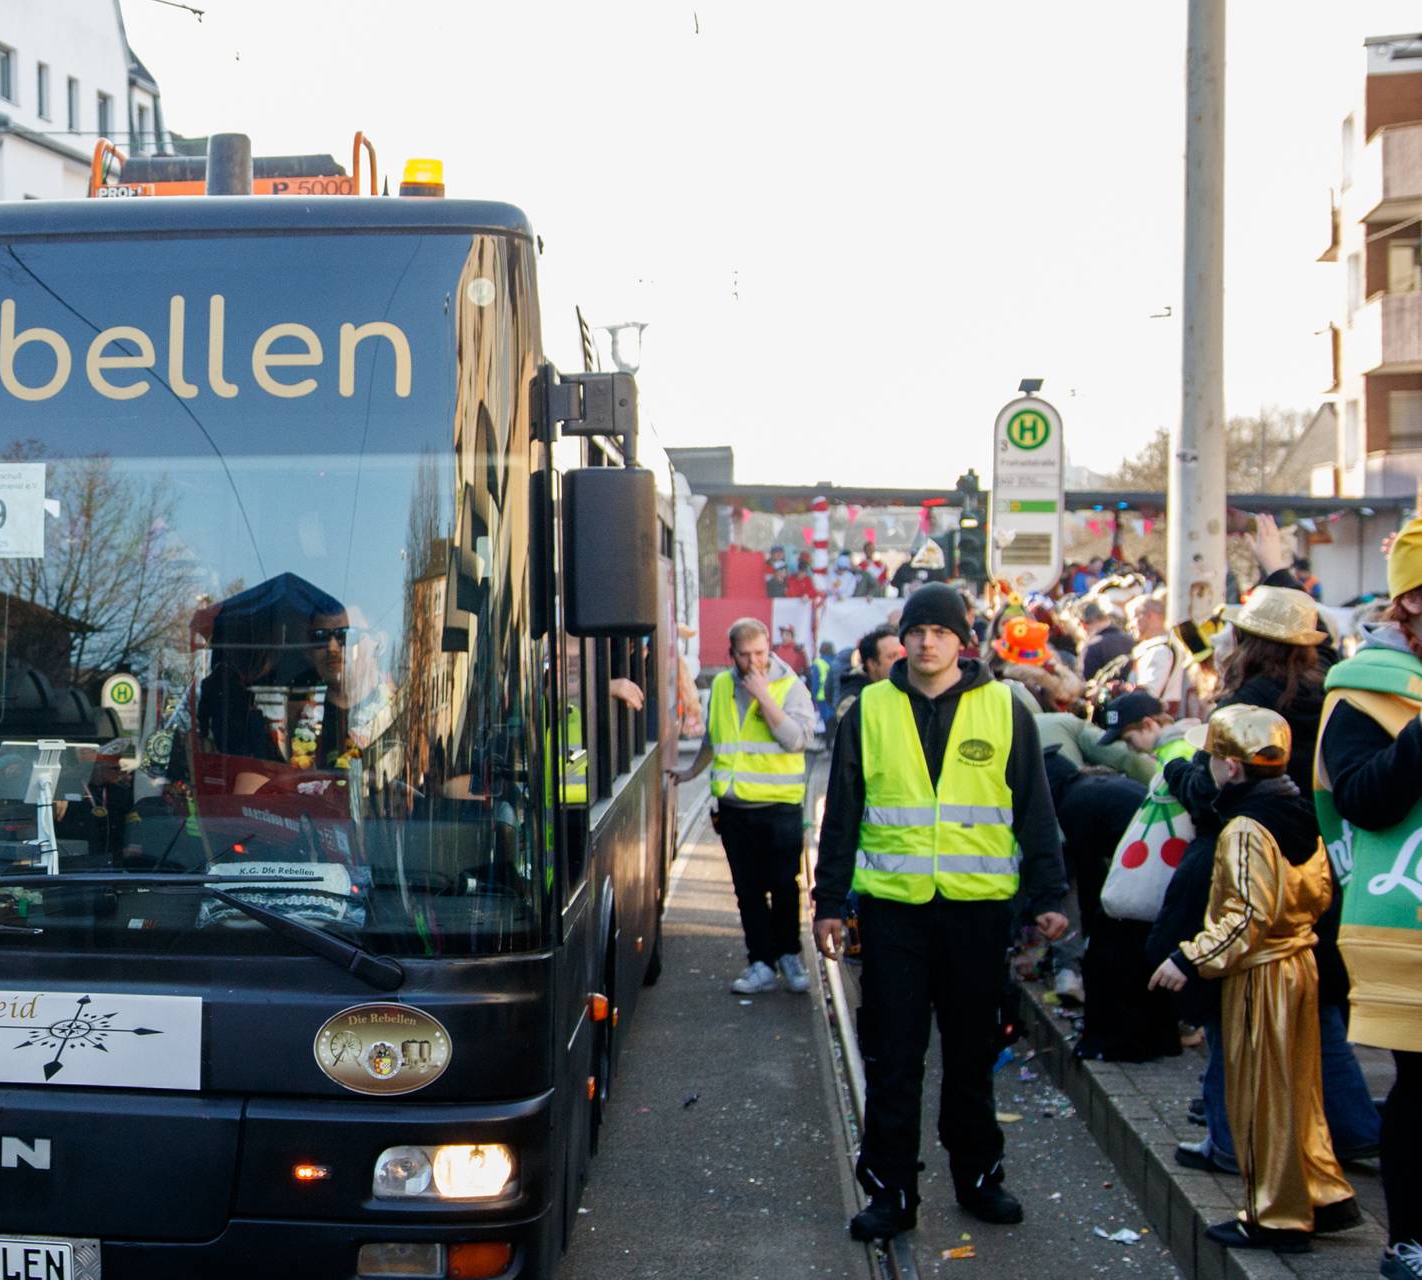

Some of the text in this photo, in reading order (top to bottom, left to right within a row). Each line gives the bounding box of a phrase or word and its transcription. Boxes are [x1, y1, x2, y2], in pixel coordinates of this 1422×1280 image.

[297, 179, 353, 195] 5000
[1019, 419, 1038, 441] H
[239, 867, 315, 876] K.G. Die Rebellen
[347, 1012, 417, 1026] Die Rebellen
